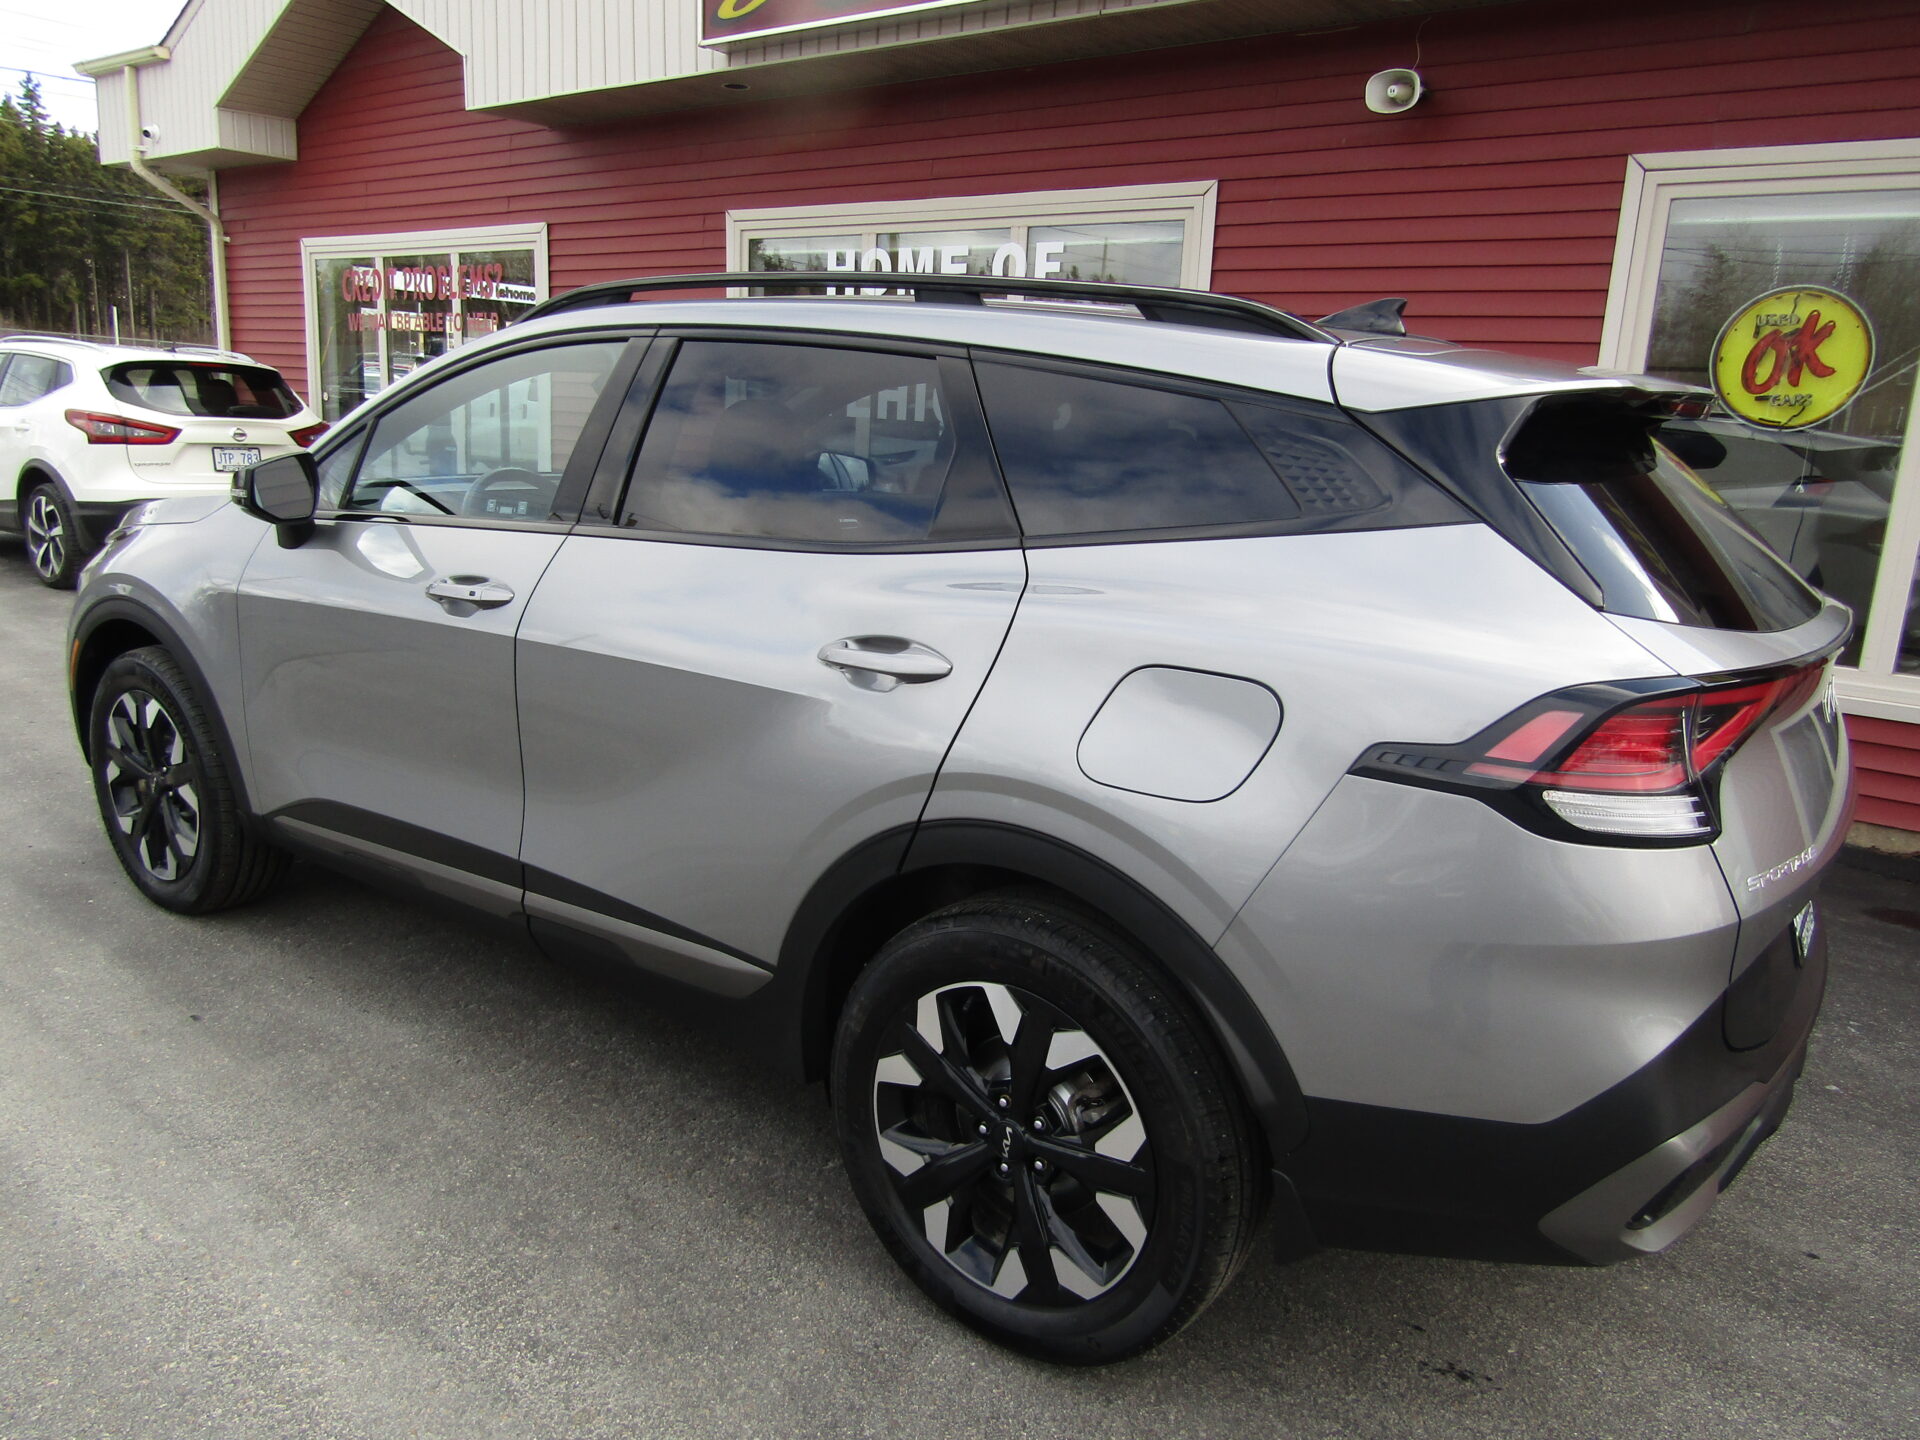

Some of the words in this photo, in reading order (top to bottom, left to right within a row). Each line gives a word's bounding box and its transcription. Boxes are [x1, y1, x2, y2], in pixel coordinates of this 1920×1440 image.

[342, 267, 397, 302] CREDIT
[403, 263, 503, 301] PROBLEMS?
[348, 313, 363, 331] WE
[397, 313, 411, 331] BE
[414, 312, 444, 331] ABLE
[446, 312, 463, 332] TO
[467, 312, 499, 332] HELP
[1741, 309, 1837, 395] OK
[217, 452, 235, 464] JTP
[240, 452, 259, 465] 783
[1746, 844, 1817, 892] SPORTAGE
